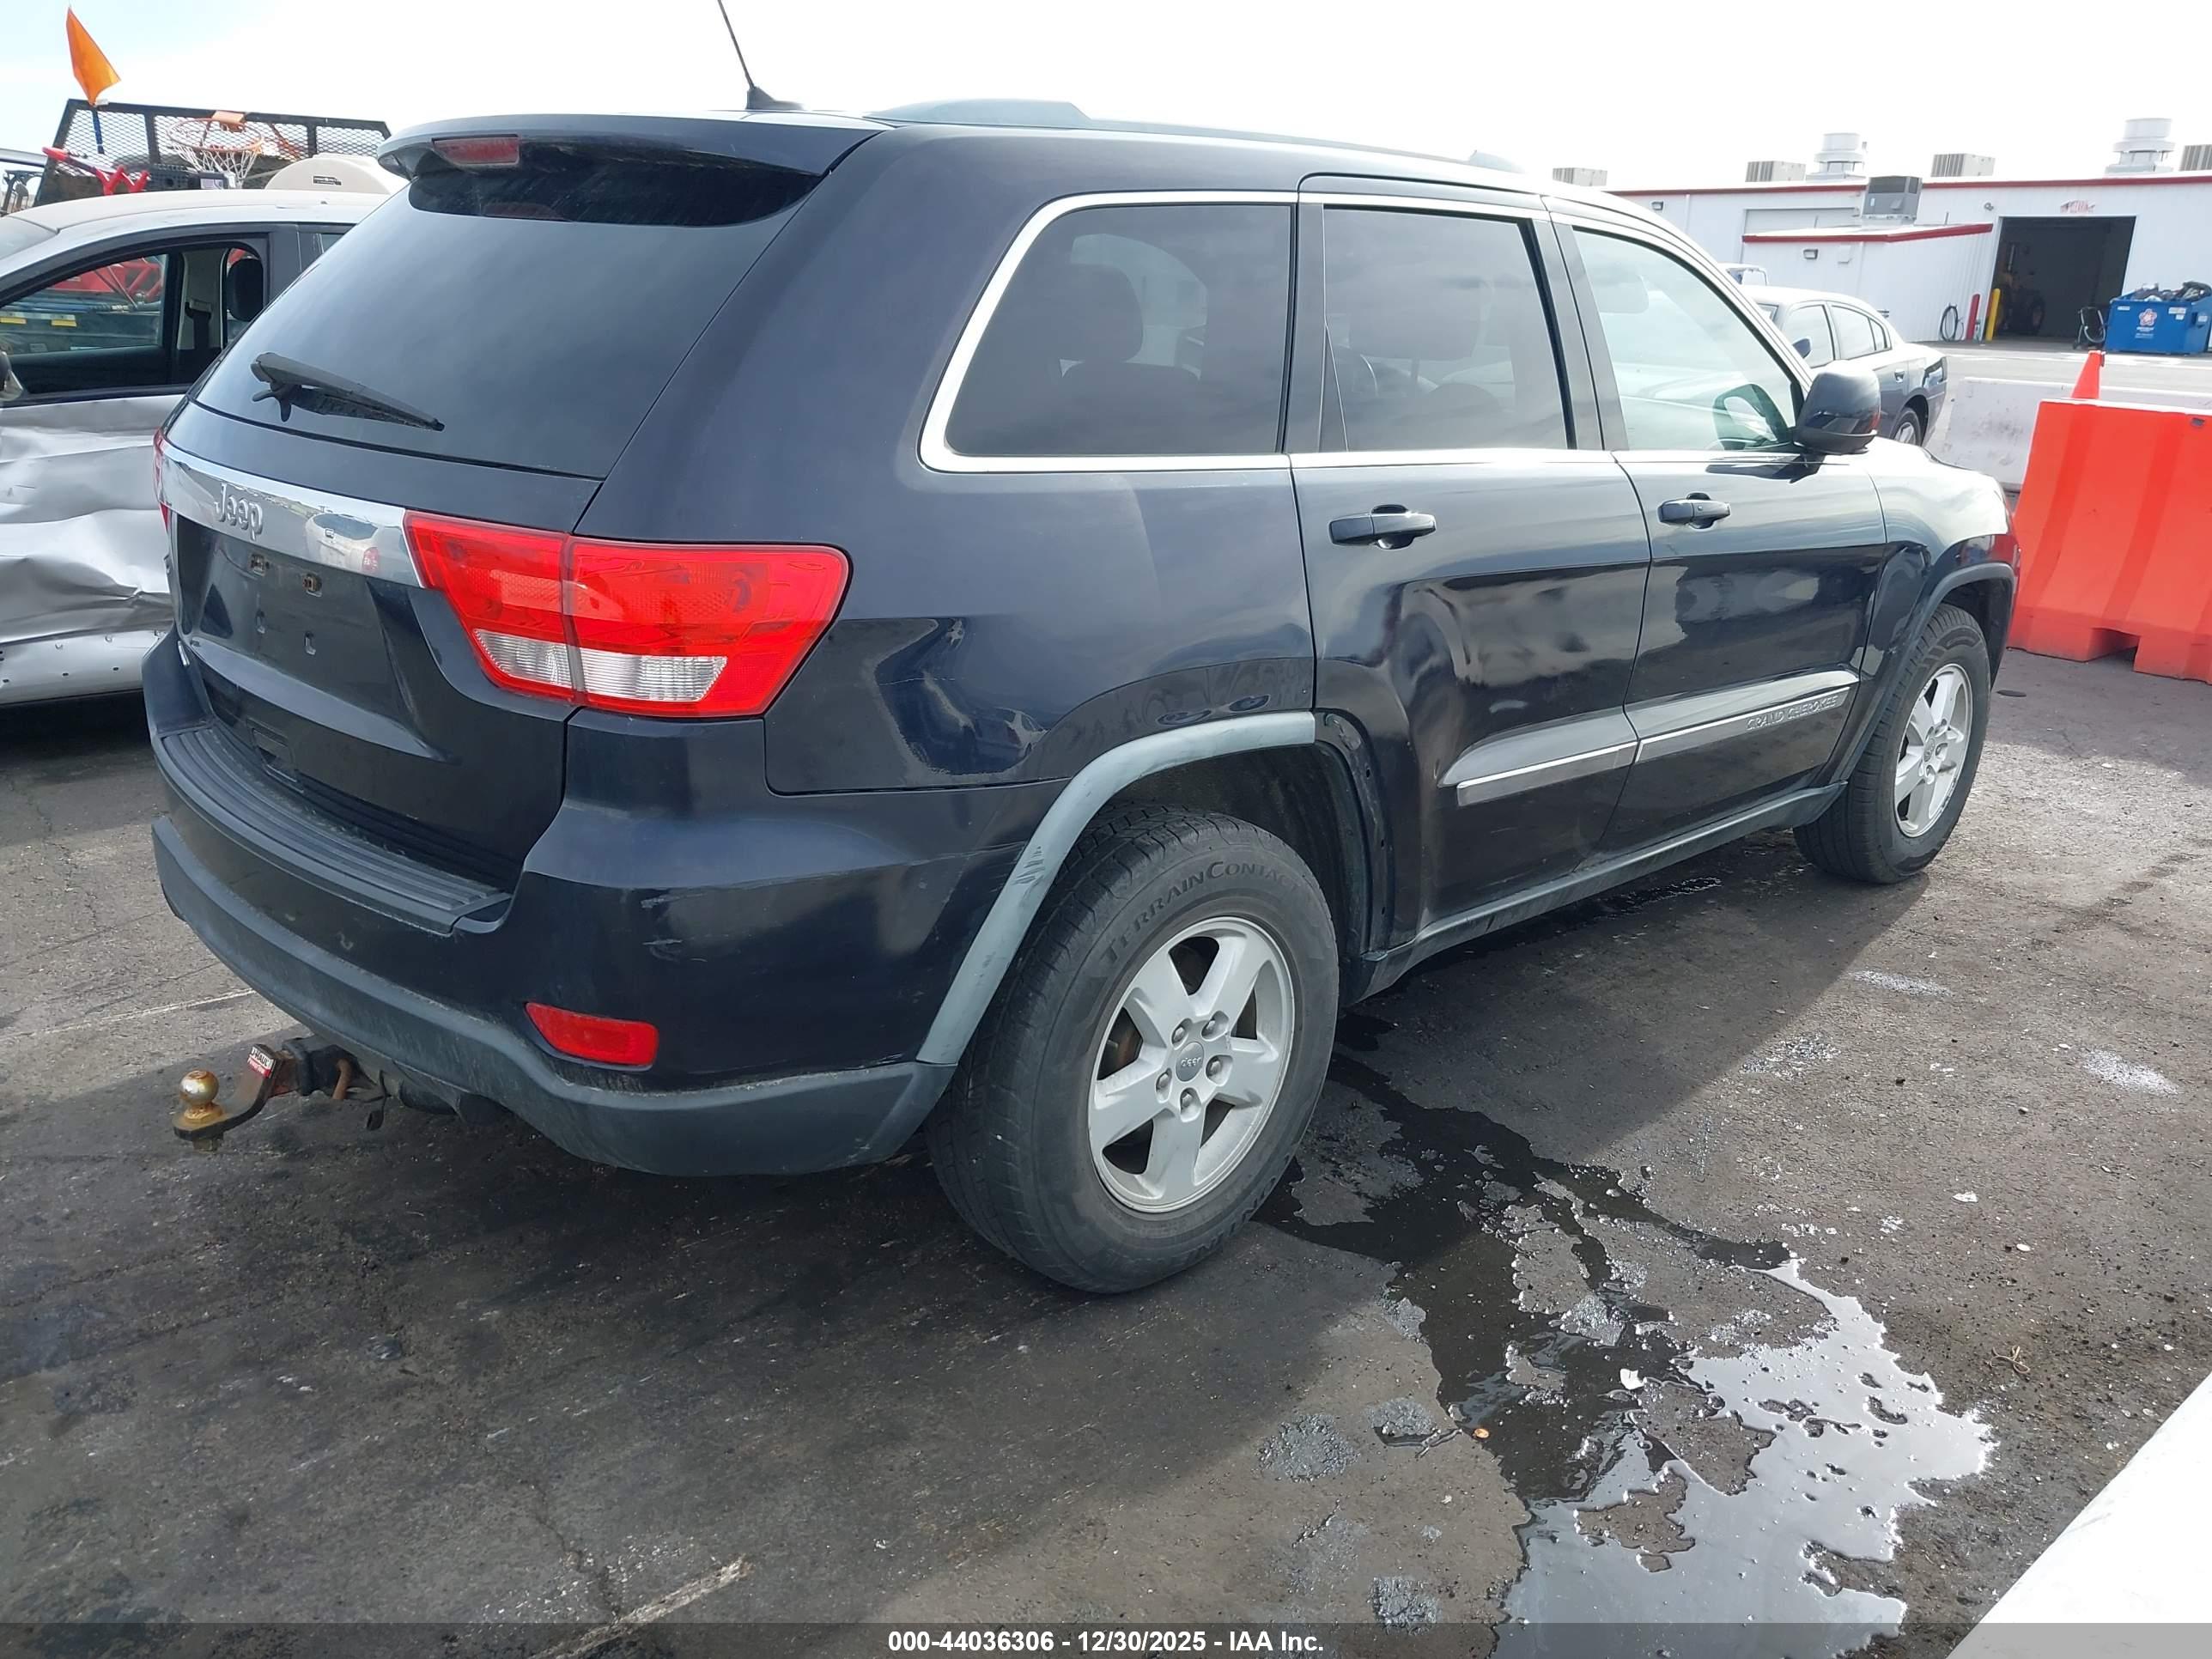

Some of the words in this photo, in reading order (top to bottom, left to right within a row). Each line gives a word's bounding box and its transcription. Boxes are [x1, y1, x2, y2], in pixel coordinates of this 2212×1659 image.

[214, 482, 263, 541] Jeep
[1746, 711, 1785, 731] GRAND
[1787, 695, 1838, 720] CHEROKEE
